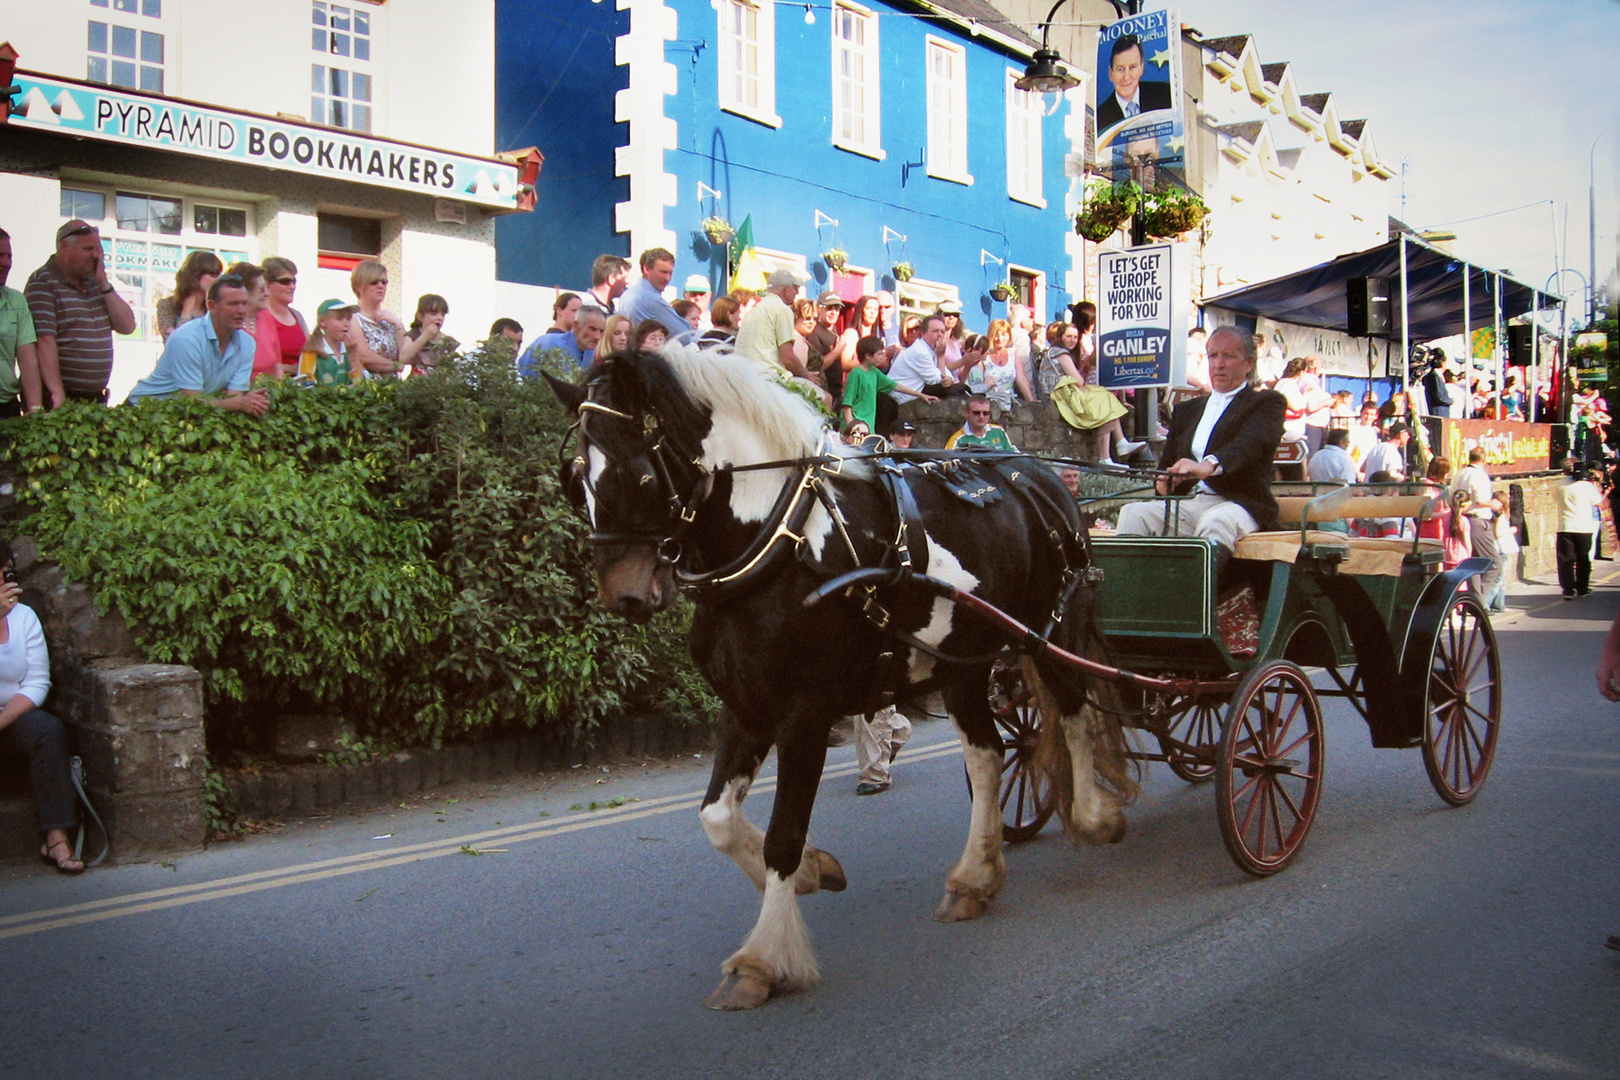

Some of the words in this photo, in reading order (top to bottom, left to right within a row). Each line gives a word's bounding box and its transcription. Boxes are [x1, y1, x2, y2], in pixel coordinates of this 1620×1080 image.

[1099, 10, 1167, 46] MOONEY
[1136, 26, 1168, 45] Paschal
[96, 97, 237, 151] PYRAMID
[247, 125, 457, 190] BOOKMAKERS
[116, 240, 177, 256] PYRAMID
[102, 252, 181, 269] OOKMAKE
[1109, 255, 1138, 274] LET'S
[1140, 254, 1161, 271] GET
[1112, 270, 1157, 290] EUROPE
[1107, 286, 1162, 305] WORKING
[1111, 305, 1133, 321] FOR
[1135, 302, 1158, 319] YOU
[1125, 330, 1145, 338] DECLAN
[1103, 335, 1168, 357] GANLEY
[1137, 355, 1156, 363] EUROPE
[1114, 365, 1154, 377] Libertas.eu
